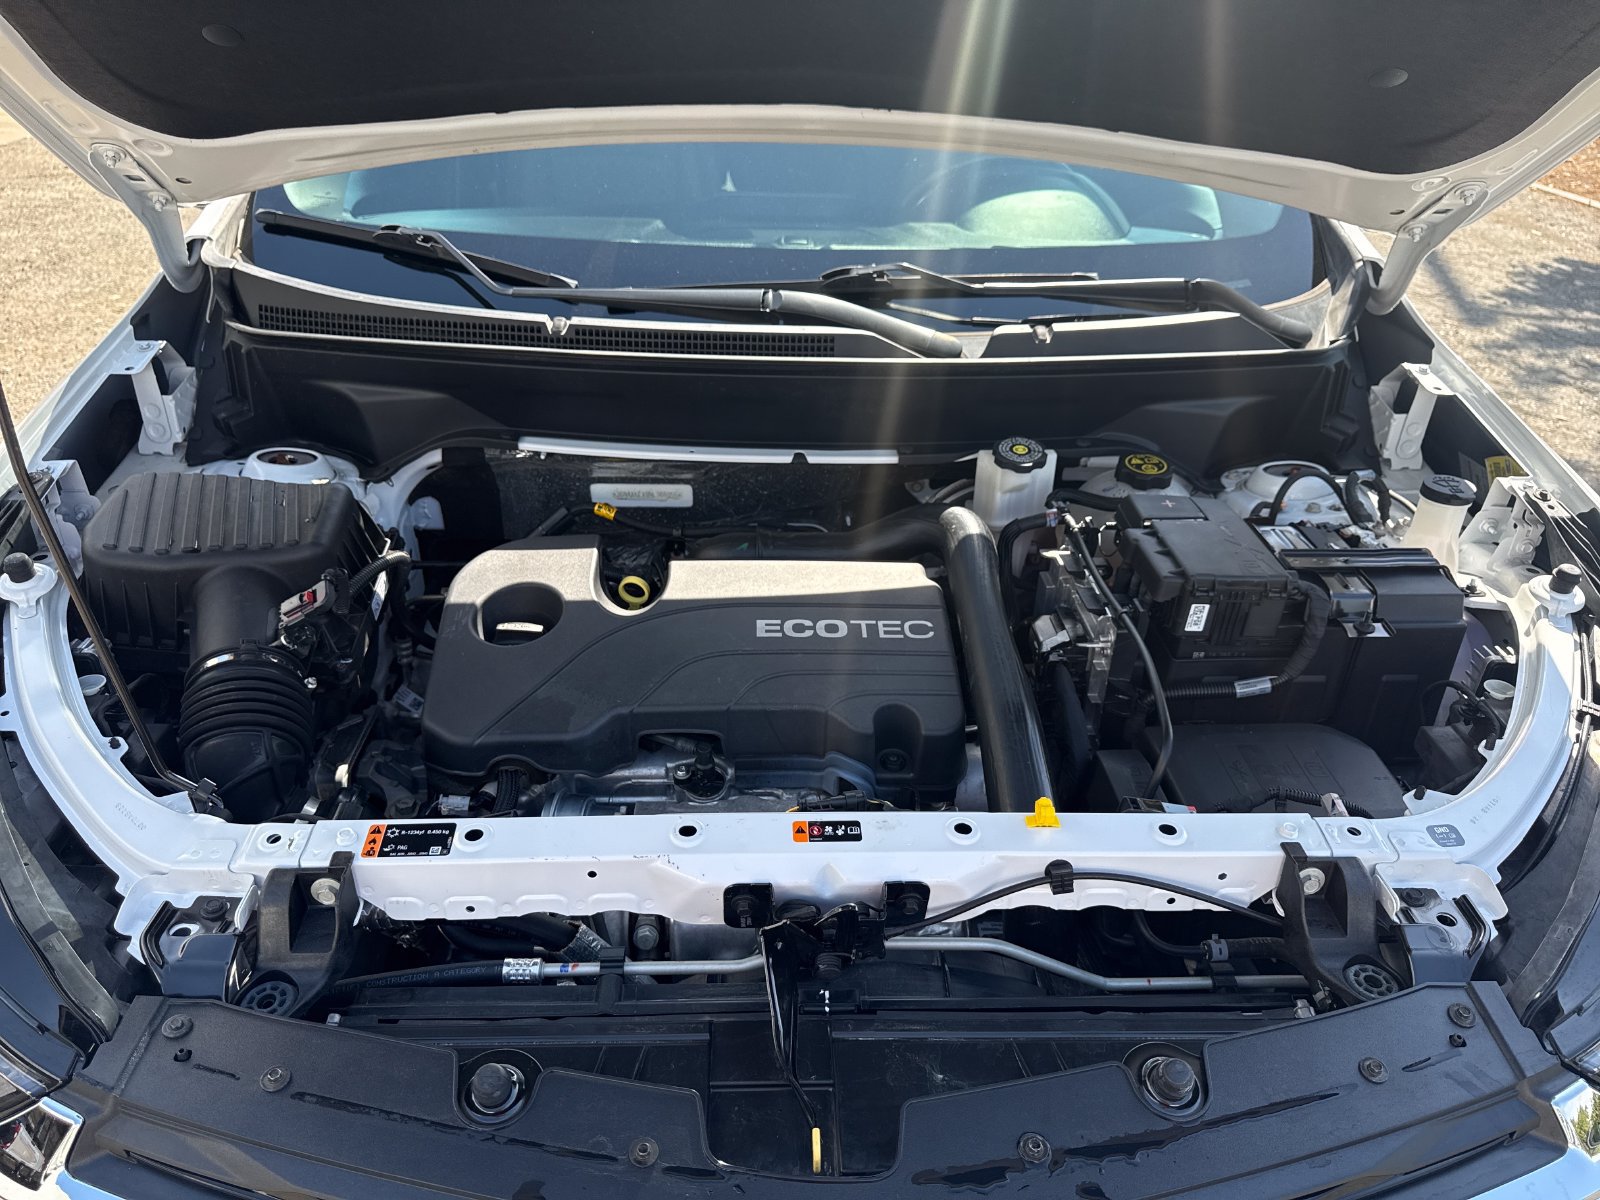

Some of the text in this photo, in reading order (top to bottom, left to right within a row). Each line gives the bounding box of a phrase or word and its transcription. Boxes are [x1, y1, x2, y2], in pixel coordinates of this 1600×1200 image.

[755, 619, 935, 639] ECOTEC
[1434, 826, 1449, 834] GND
[366, 972, 430, 988] CONSTRUCTION
[443, 966, 487, 978] CATEGORY
